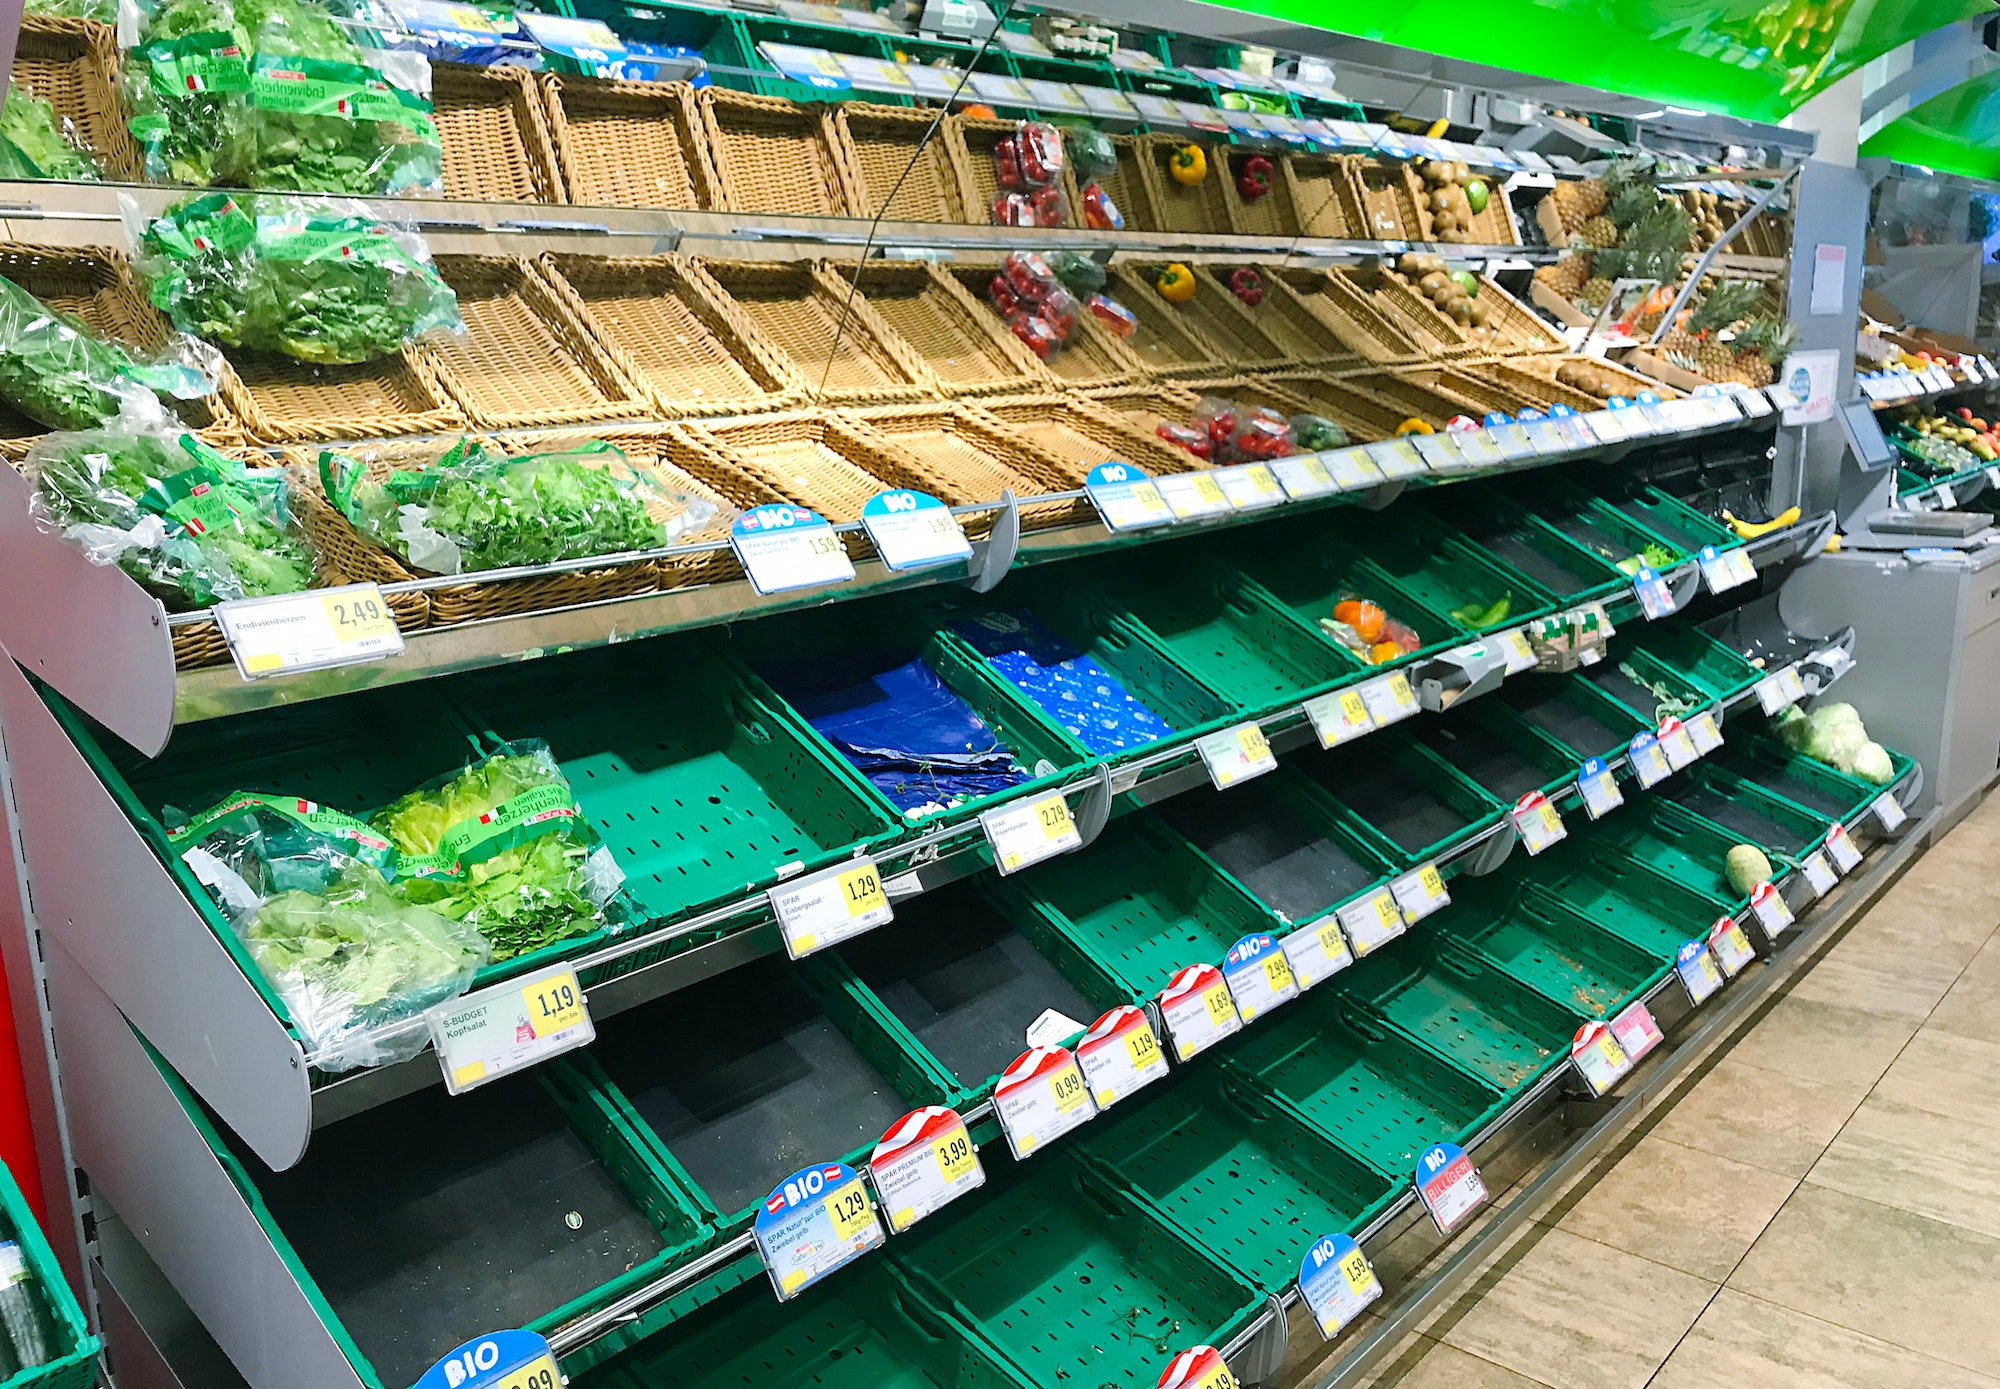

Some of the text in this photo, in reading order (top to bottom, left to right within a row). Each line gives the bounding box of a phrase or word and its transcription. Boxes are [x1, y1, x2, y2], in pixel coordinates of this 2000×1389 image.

[755, 507, 796, 530] BIO
[235, 614, 307, 631] Endivienherzen
[333, 599, 380, 627] 2,49
[1042, 805, 1065, 826] 2,79
[848, 875, 876, 902] 1,29
[782, 895, 799, 907] SPAR
[785, 897, 822, 916] Eisbergsalat
[1238, 938, 1260, 961] BIO
[1268, 959, 1286, 980] 2,99
[538, 984, 575, 1018] 1,19
[1209, 991, 1229, 1013] 1,69
[443, 1006, 488, 1028] S-BUDGET
[446, 1019, 487, 1039] Kopfsalat
[1132, 1033, 1153, 1057] 1,19
[1056, 1073, 1080, 1100] 0,99
[1005, 1099, 1020, 1110] SPAR
[1008, 1104, 1028, 1119] Zwiebel
[940, 1138, 968, 1167] 3,99
[880, 1167, 898, 1182] SPAR
[897, 1153, 924, 1173] PREMIUM
[884, 1168, 919, 1191] Zwiebel gelb
[783, 1170, 824, 1207] BIO
[835, 1191, 864, 1223] 1,29
[767, 1229, 786, 1244] SPAR
[815, 1205, 826, 1216] BIO
[772, 1227, 809, 1253] Zwiebel gelb
[1312, 1239, 1335, 1267] BIO
[1347, 1258, 1366, 1282] 1,59
[444, 1341, 499, 1389] BIO
